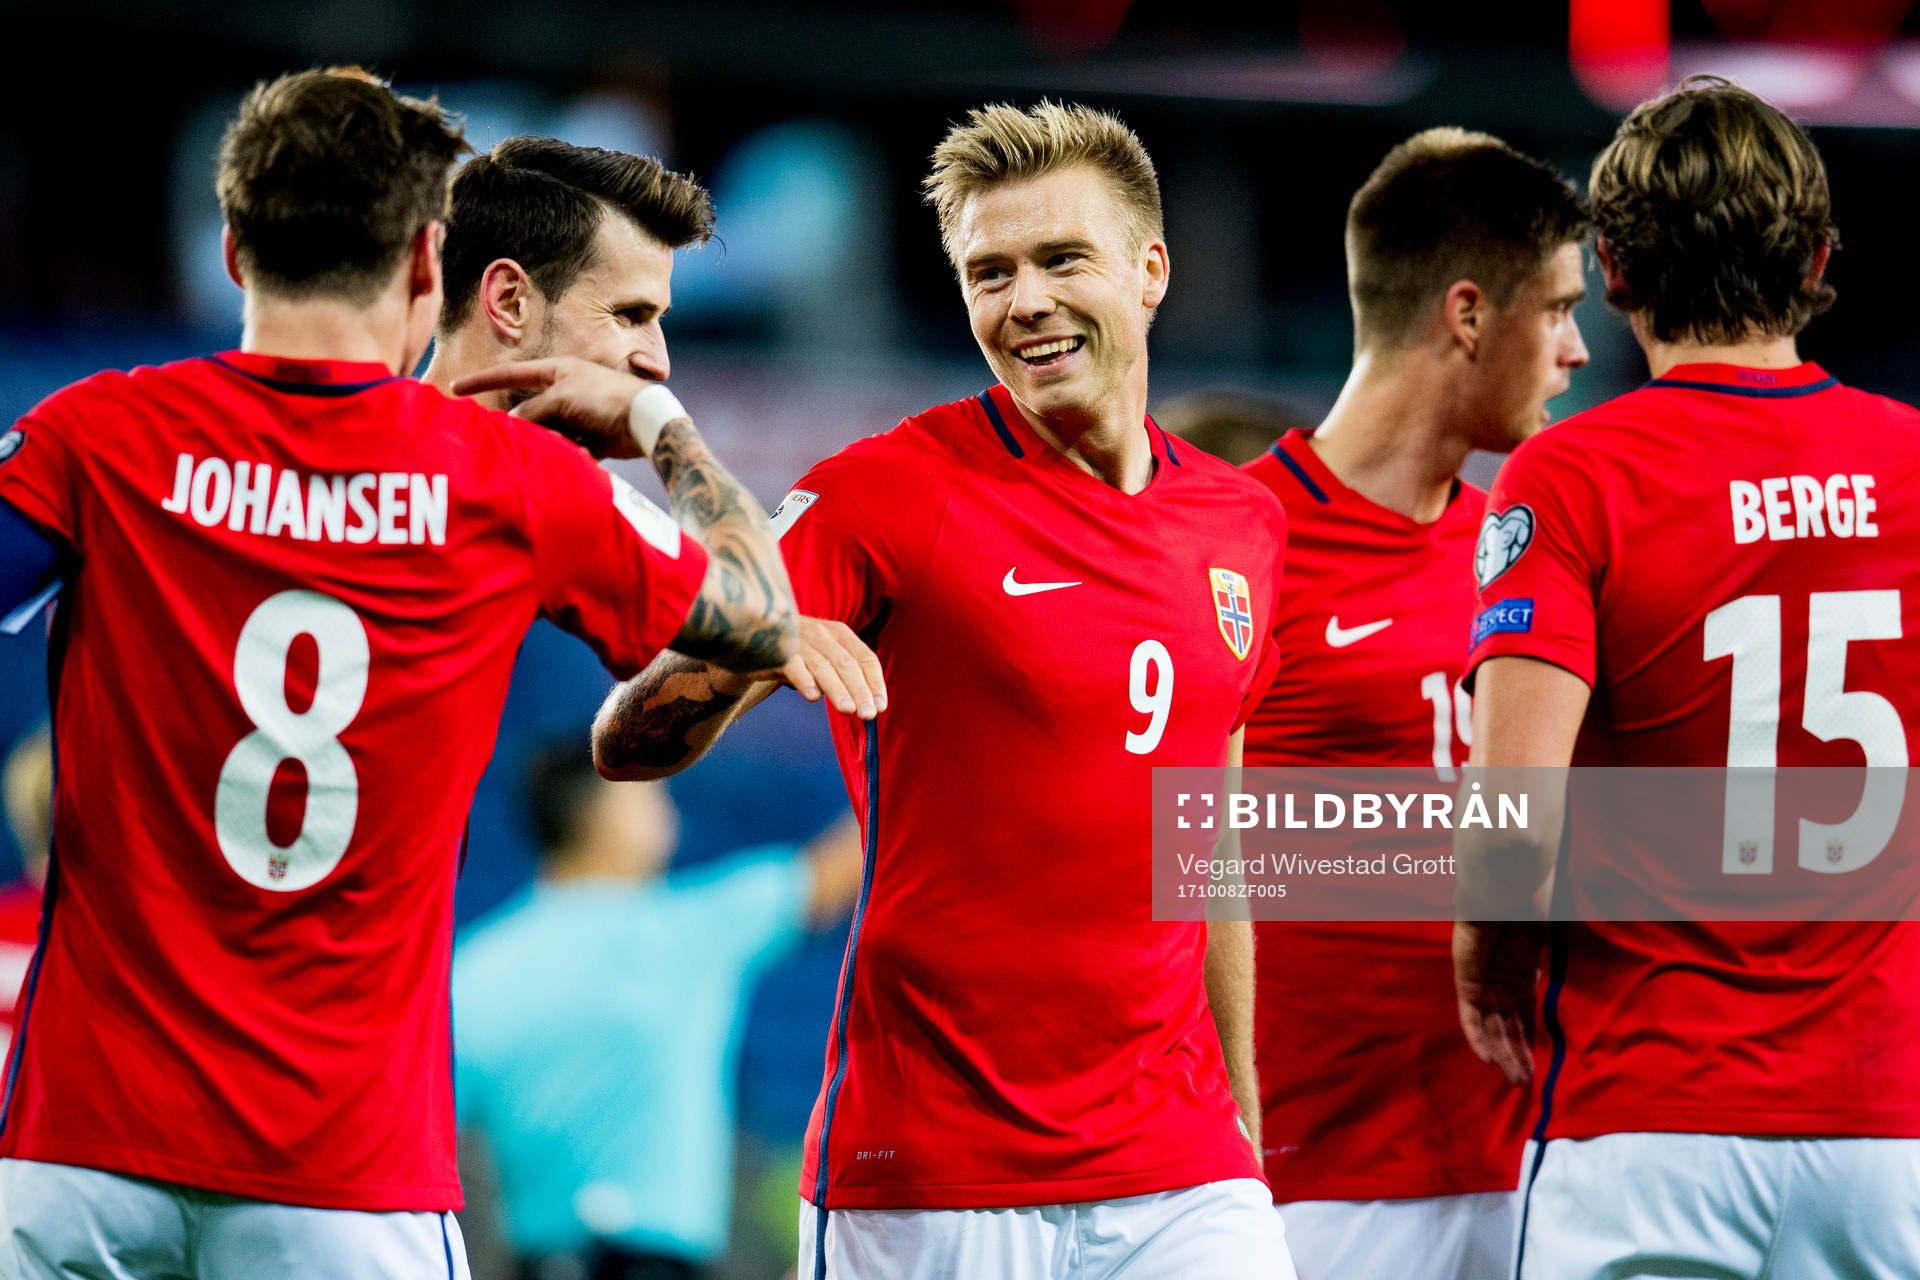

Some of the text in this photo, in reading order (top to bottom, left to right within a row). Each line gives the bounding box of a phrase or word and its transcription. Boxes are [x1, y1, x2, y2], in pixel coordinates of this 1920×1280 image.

[161, 453, 449, 546] JOHANSEN
[1729, 473, 1879, 545] BERGE
[214, 589, 371, 892] 8
[1124, 639, 1175, 755] 9
[1703, 589, 1909, 874] 15
[856, 1150, 896, 1160] DRI-FIT
